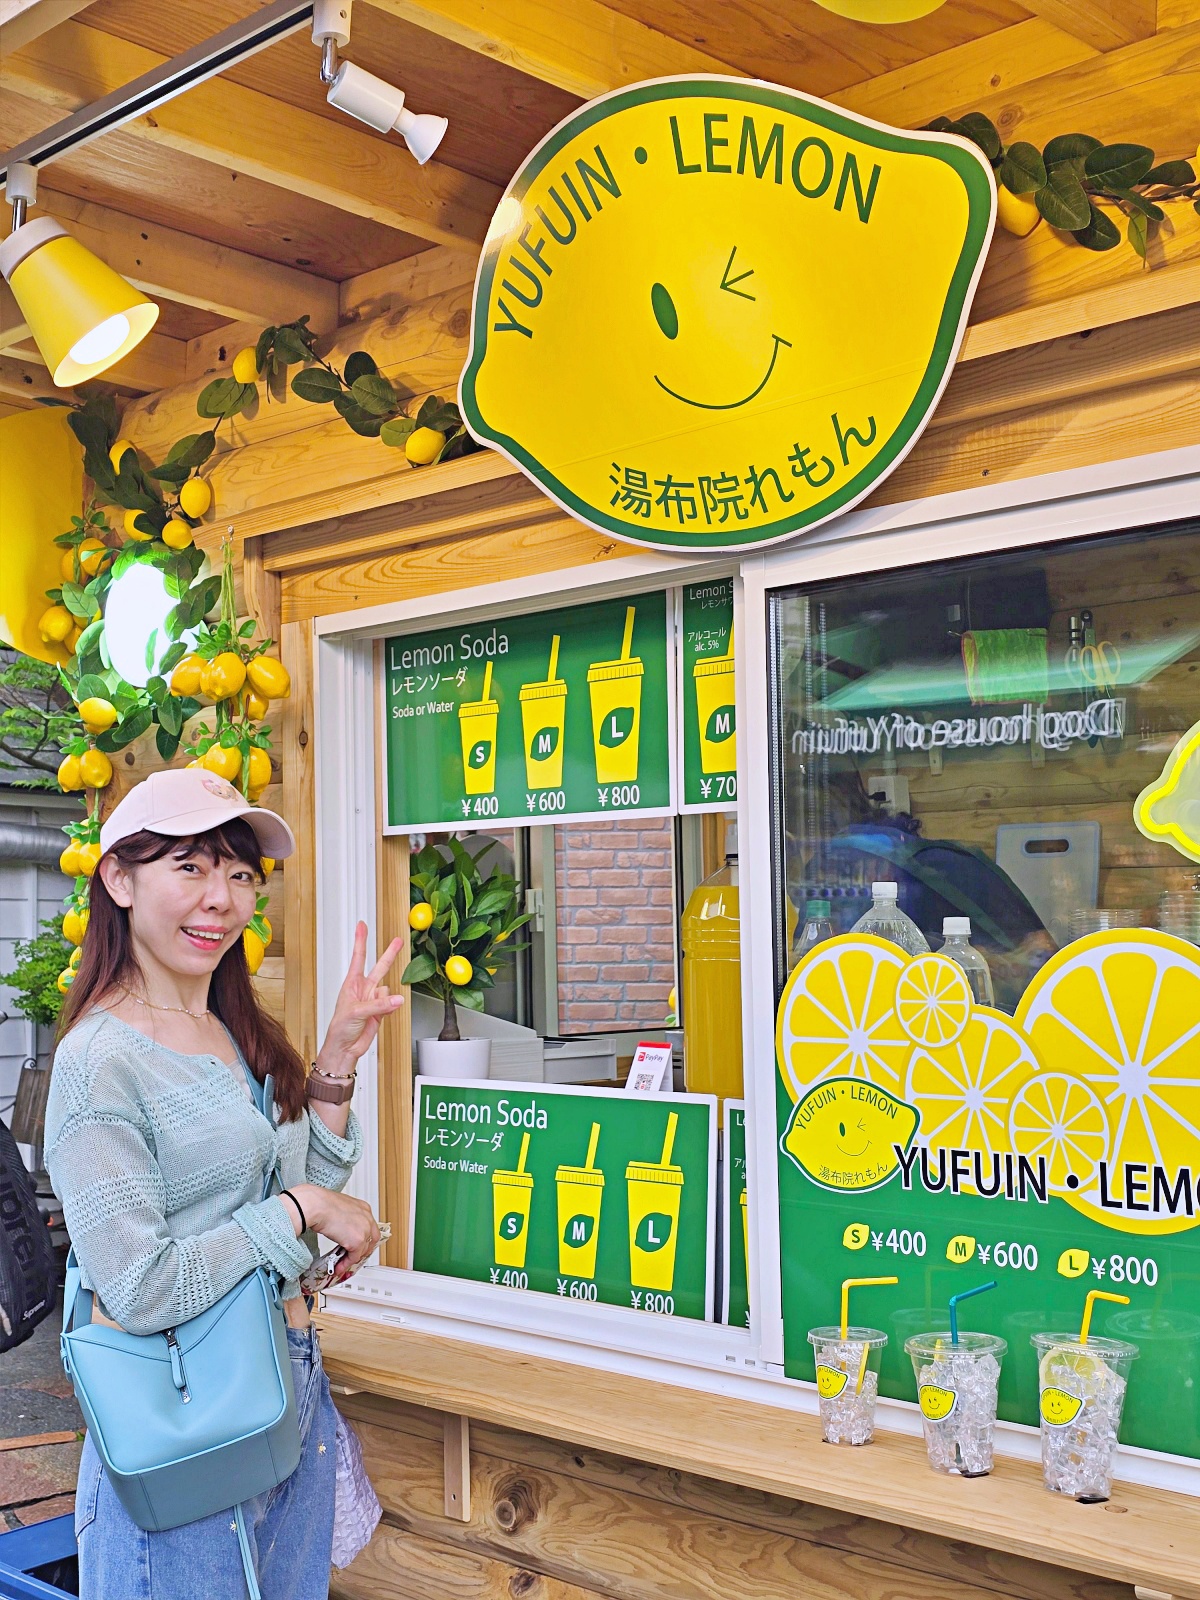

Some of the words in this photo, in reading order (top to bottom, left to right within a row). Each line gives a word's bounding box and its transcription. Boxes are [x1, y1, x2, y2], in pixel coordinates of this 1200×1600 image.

[493, 145, 622, 338] YUFUIN
[669, 113, 882, 224] LEMON
[608, 412, 877, 525] 湯布院れもん
[690, 585, 726, 600] Lemon
[688, 627, 726, 642] アルコール
[707, 640, 720, 650] 5%
[391, 643, 454, 671] Lemon
[460, 628, 509, 660] Soda
[392, 666, 468, 696] レモンソーダ
[392, 704, 414, 719] Soda
[415, 705, 425, 717] or
[427, 701, 454, 714] Water
[611, 716, 624, 738] L
[715, 713, 730, 734] M
[475, 746, 485, 763] S
[538, 734, 551, 754] M
[646, 1053, 664, 1062] PayPay
[425, 1094, 491, 1124] Lemon
[496, 1099, 548, 1129] Soda
[795, 1087, 837, 1130] YUFUIN
[850, 1085, 898, 1119] LEMON
[425, 1126, 504, 1152] レモンソーダ
[423, 1156, 446, 1170] Soda
[447, 1160, 458, 1171] or
[459, 1159, 488, 1174] Water
[818, 1162, 887, 1185] 湯布院れもん
[893, 1145, 1047, 1202] YUFUIN
[1099, 1160, 1200, 1215] LEM
[506, 1217, 517, 1234] S
[572, 1221, 585, 1241] M
[648, 1219, 661, 1244] L
[851, 1229, 861, 1244] S
[870, 1228, 927, 1257] ¥400
[954, 1242, 967, 1257] M
[977, 1241, 1039, 1271] ¥600
[1069, 1255, 1079, 1271] L
[1091, 1254, 1159, 1286] ¥800
